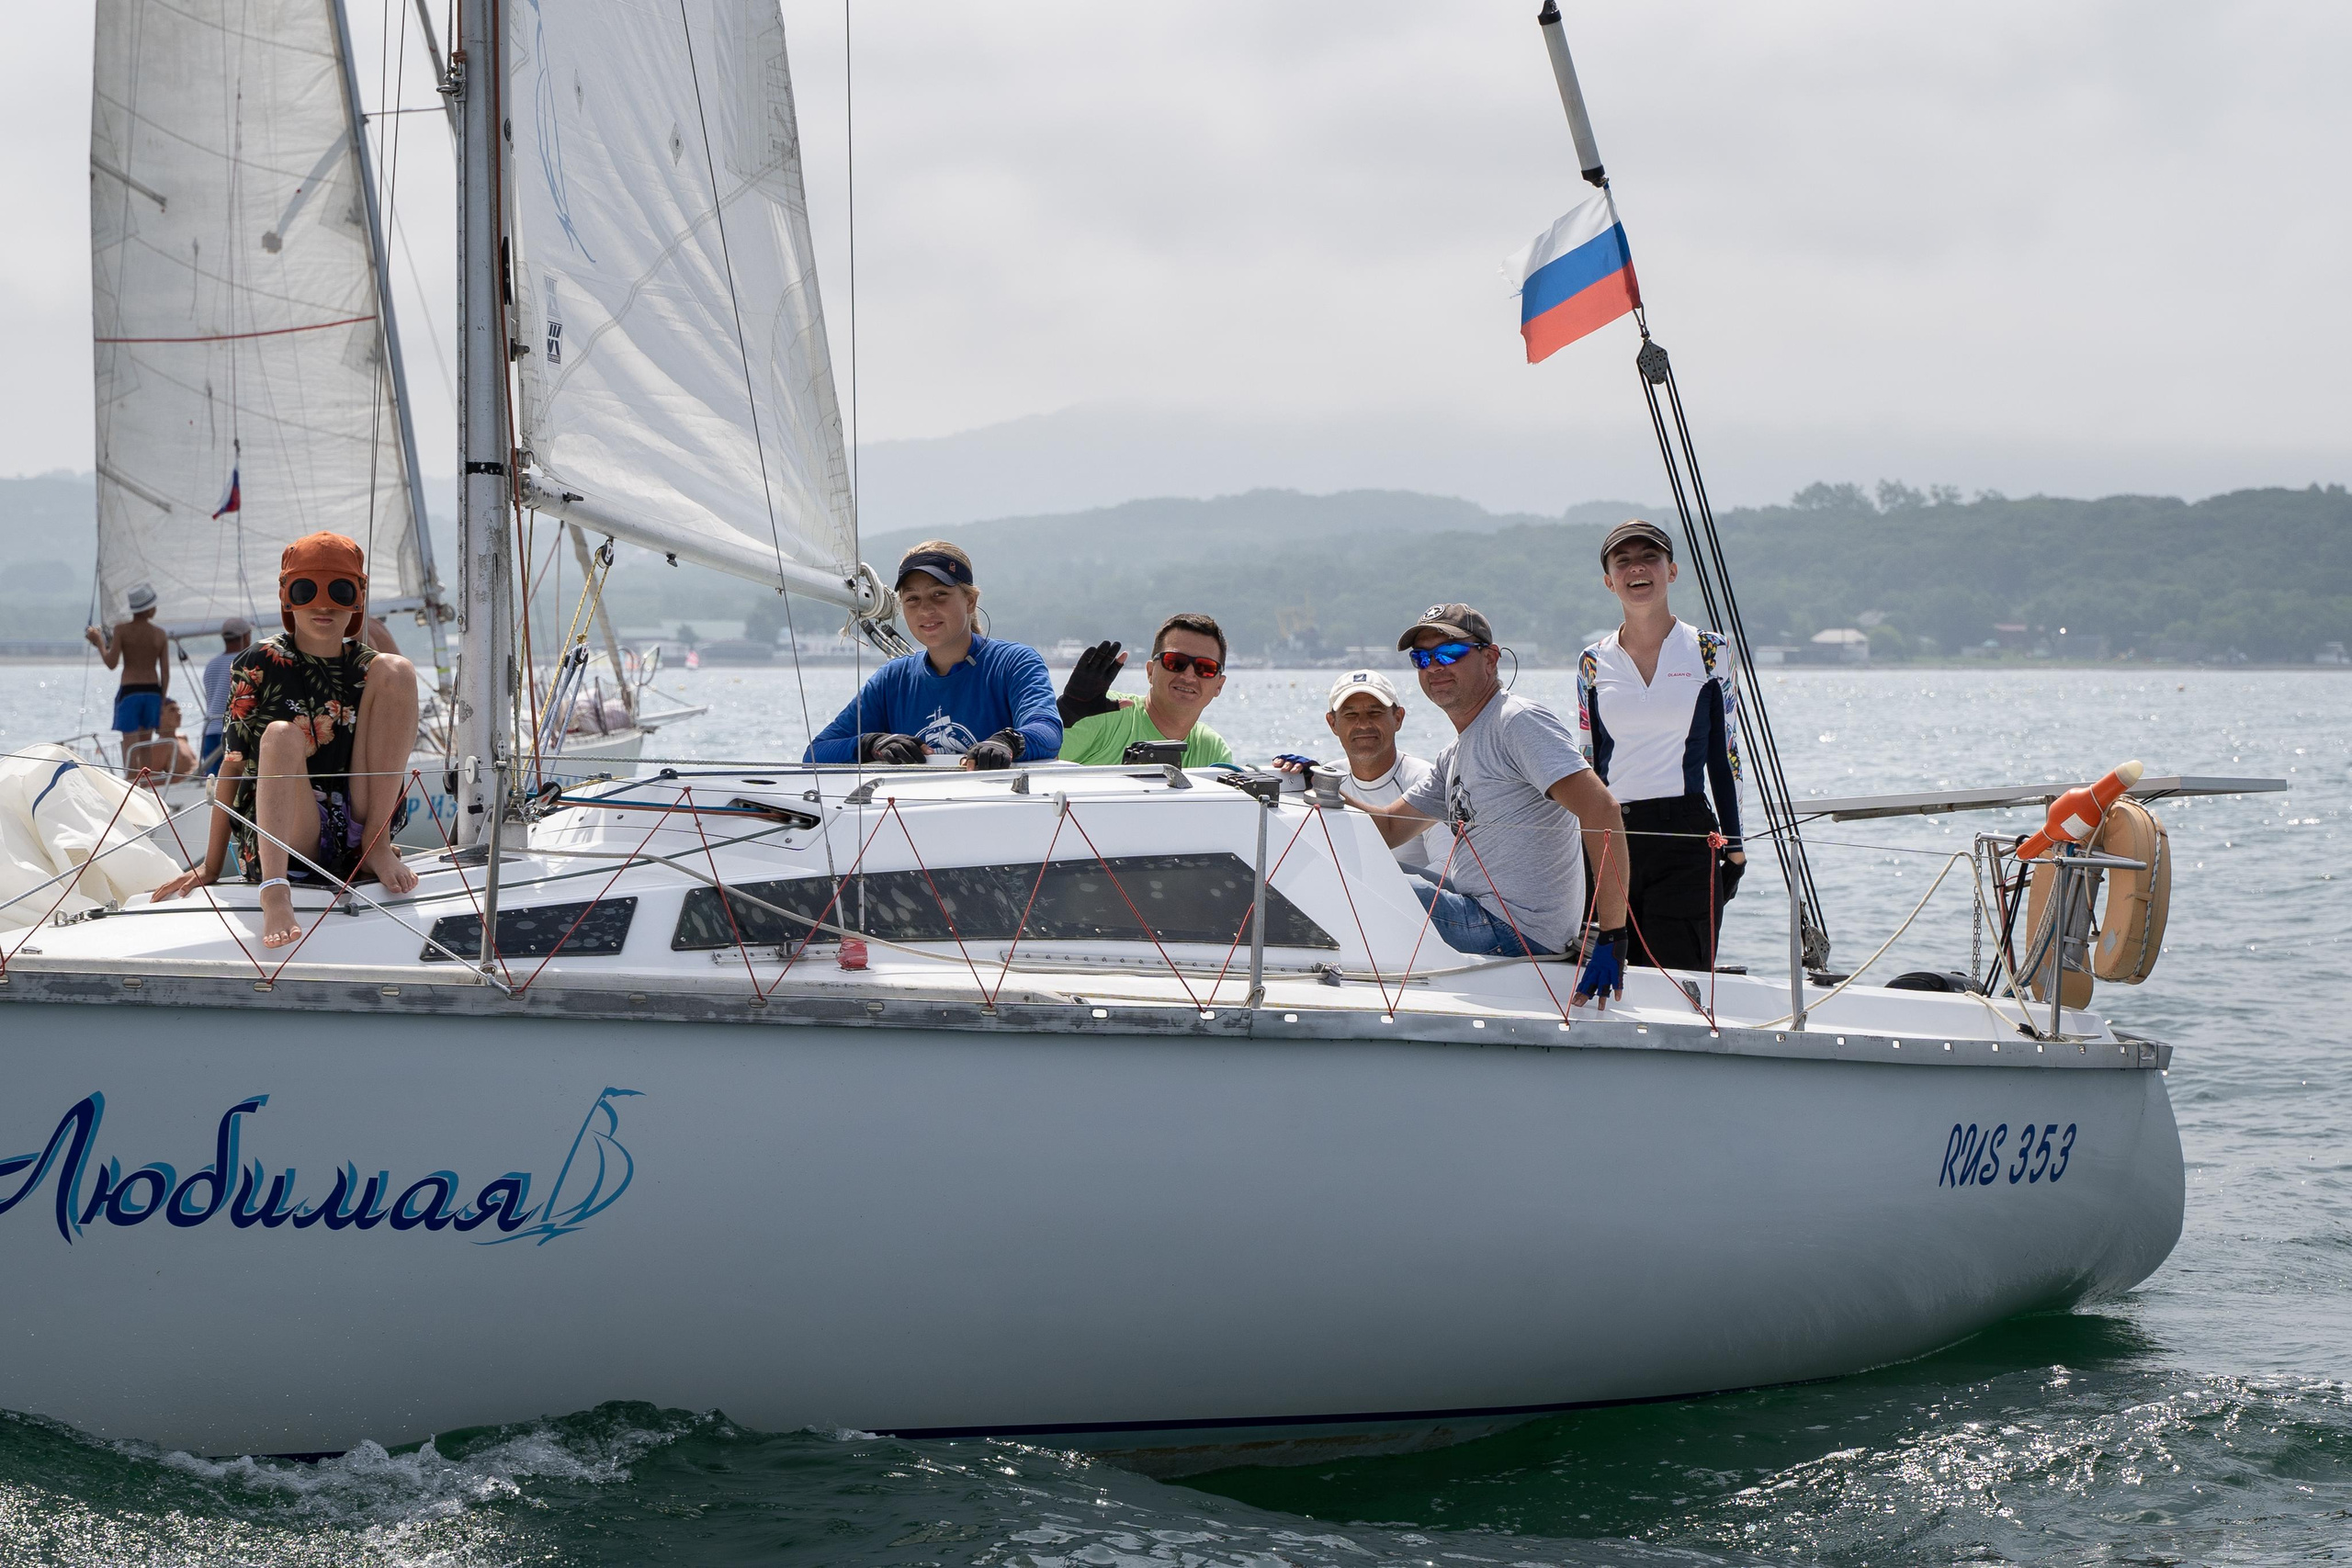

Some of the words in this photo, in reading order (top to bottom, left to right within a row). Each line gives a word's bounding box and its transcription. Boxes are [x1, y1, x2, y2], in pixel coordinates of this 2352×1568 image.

[0, 1090, 538, 1246] Любимая
[1939, 1122, 2007, 1189] RUS
[2009, 1122, 2076, 1184] 353
